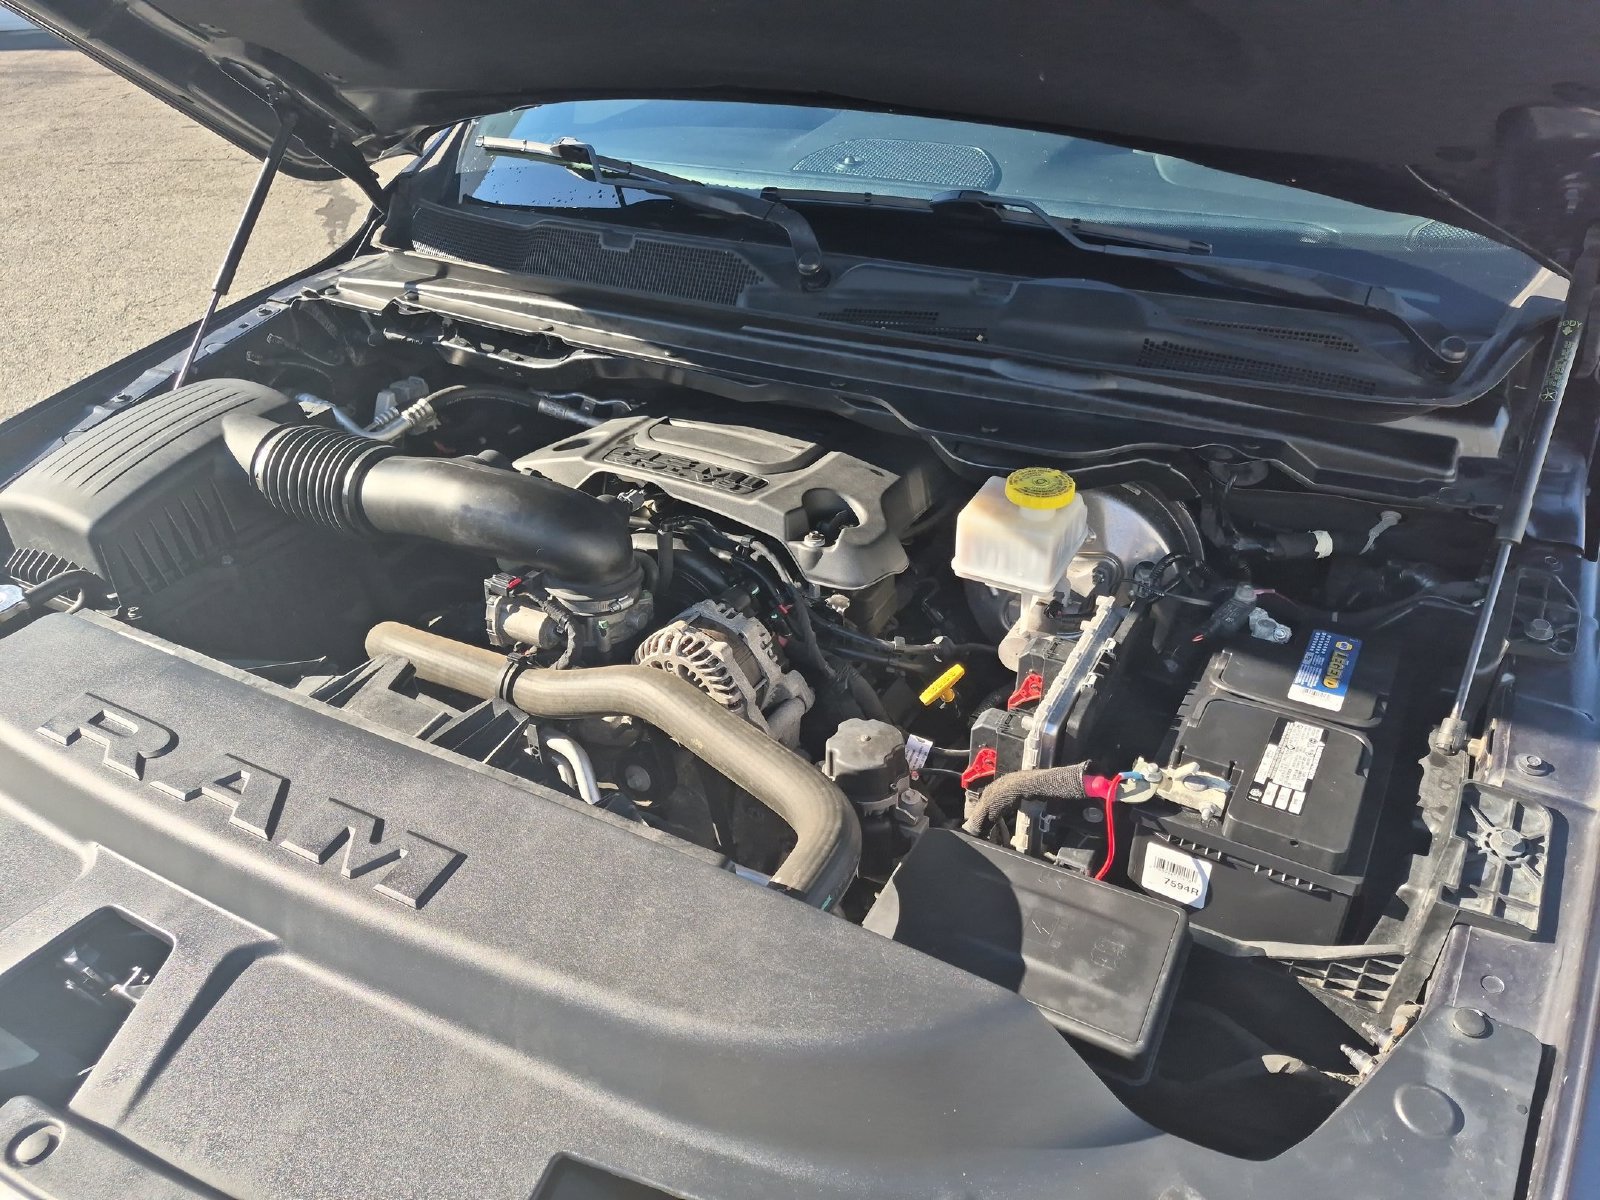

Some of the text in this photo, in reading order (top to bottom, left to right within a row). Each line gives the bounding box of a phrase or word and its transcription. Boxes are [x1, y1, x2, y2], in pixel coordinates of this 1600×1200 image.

[1323, 650, 1348, 689] LEGEND
[36, 692, 467, 909] RAM
[1164, 877, 1199, 896] 7594R
